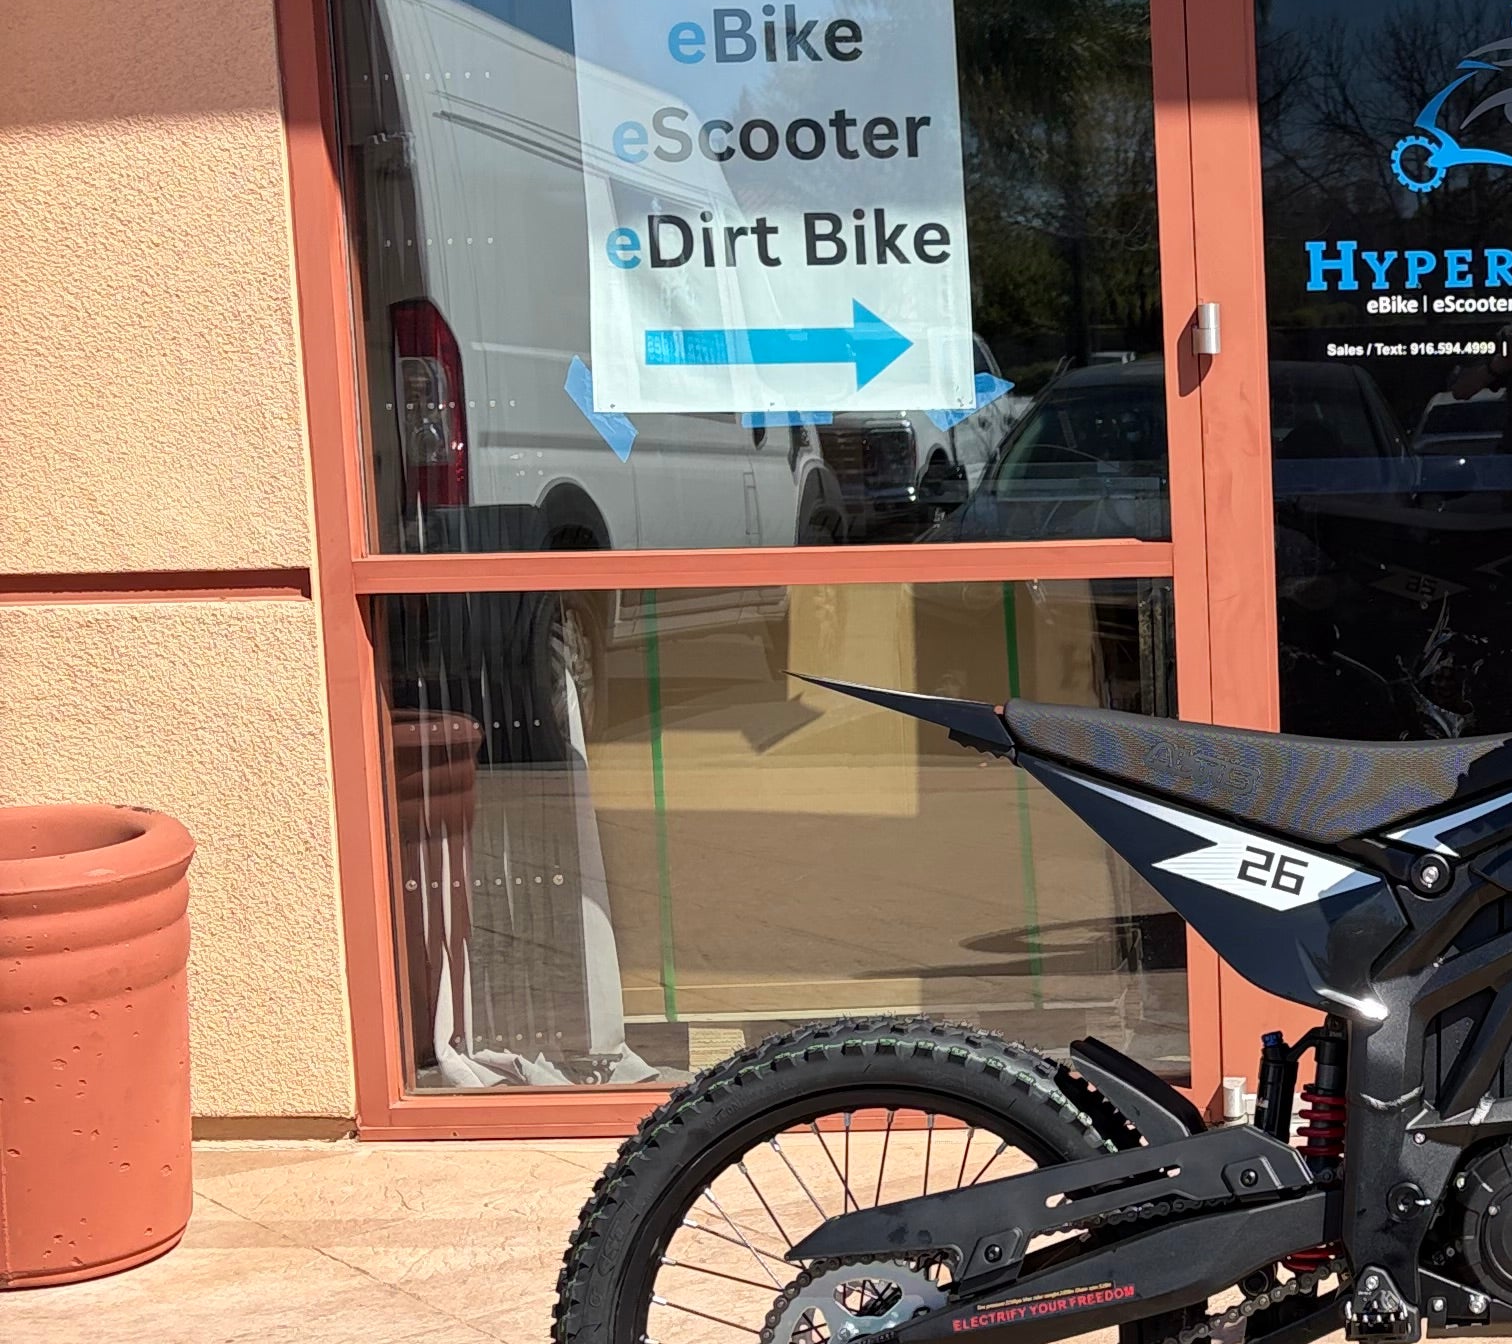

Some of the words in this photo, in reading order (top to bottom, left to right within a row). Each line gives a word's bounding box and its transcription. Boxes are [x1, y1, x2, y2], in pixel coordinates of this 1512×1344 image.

[667, 3, 865, 65] eBike
[611, 105, 932, 164] eScooter
[604, 210, 783, 270] eDirt
[803, 207, 953, 266] Bike
[1366, 295, 1418, 315] eBike
[1326, 343, 1364, 356] Sales
[1374, 342, 1407, 356] Text:
[1409, 341, 1496, 356] 916.594.4999
[1236, 845, 1309, 896] 26
[952, 1307, 1027, 1332] ELECTRIFY
[1029, 1299, 1067, 1315] YOUR
[1068, 1285, 1135, 1306] FREEDOM
